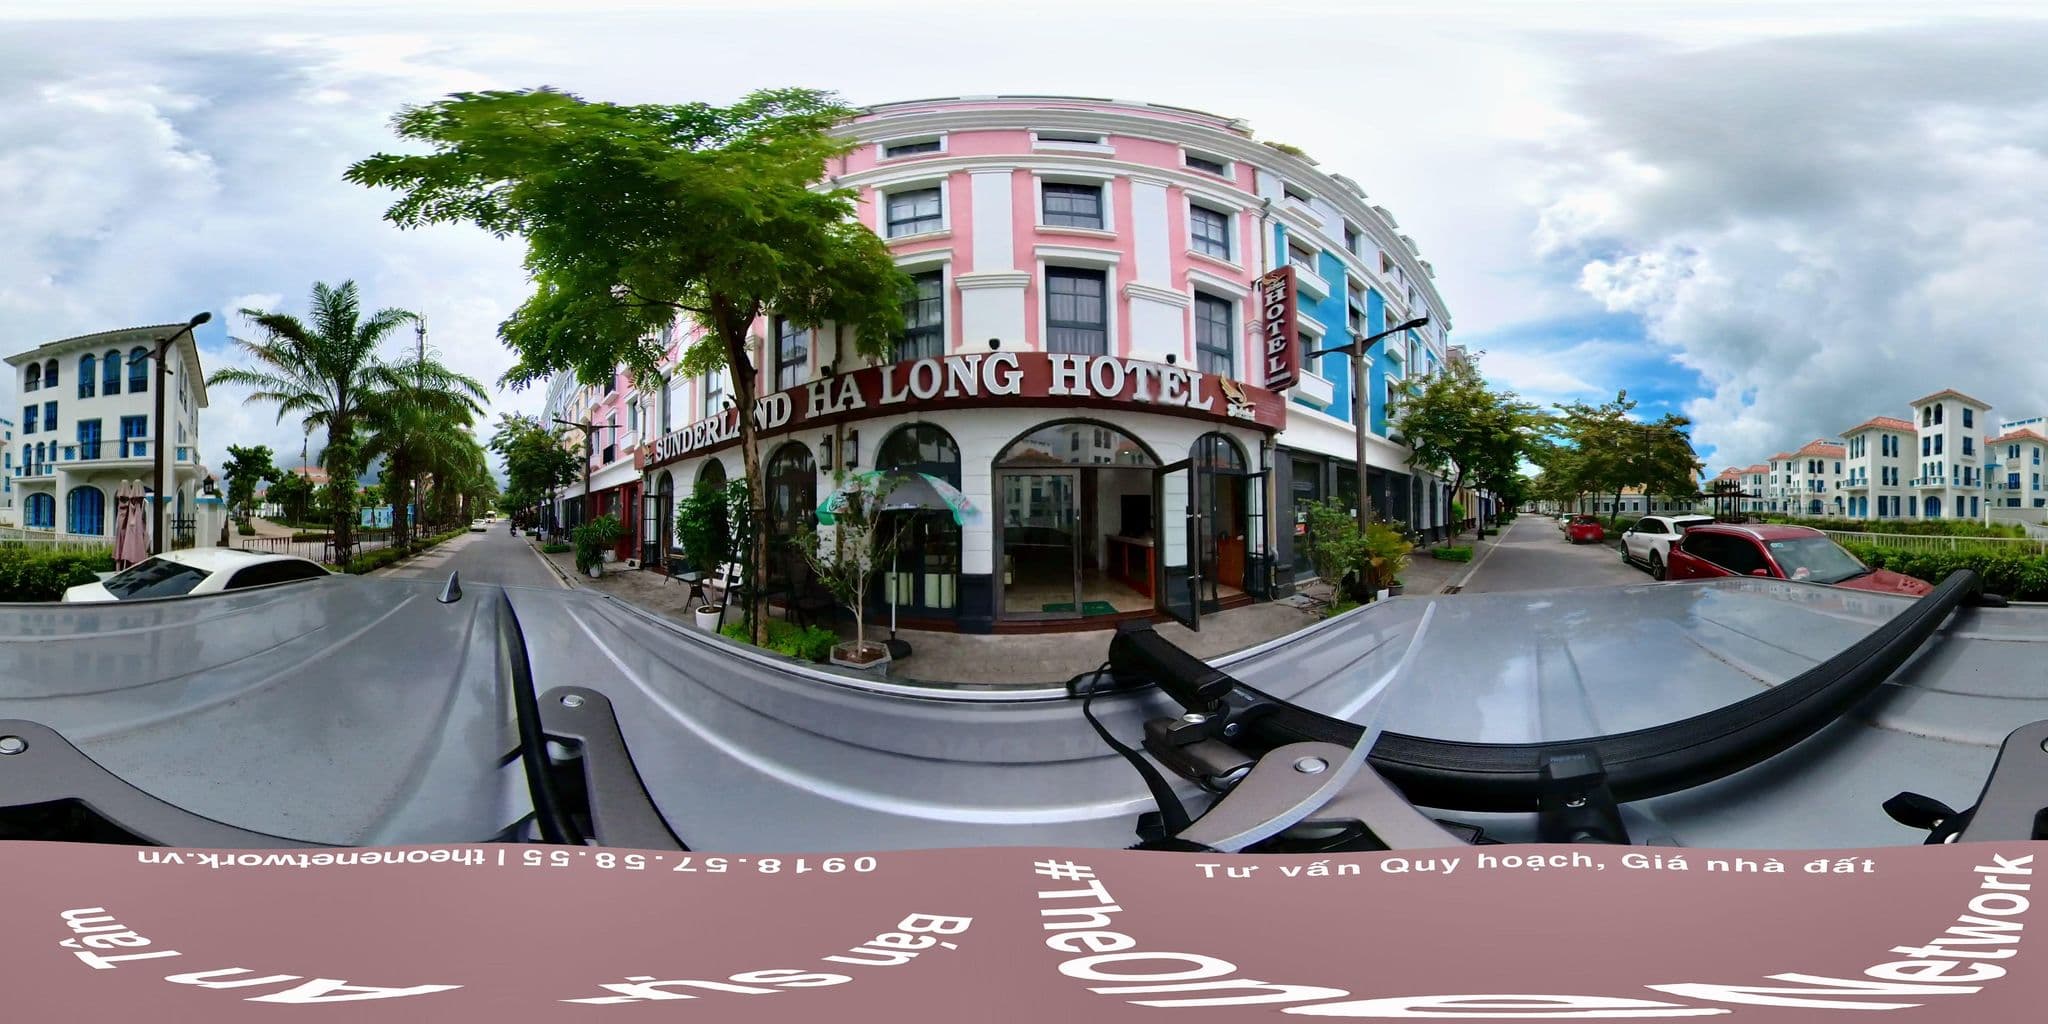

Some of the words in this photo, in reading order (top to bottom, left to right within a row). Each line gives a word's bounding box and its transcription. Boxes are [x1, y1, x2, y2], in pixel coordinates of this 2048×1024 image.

[1265, 287, 1288, 375] HOTEL
[805, 371, 866, 419] HA
[879, 352, 1024, 405] LONG
[1048, 353, 1214, 411] HOTEL
